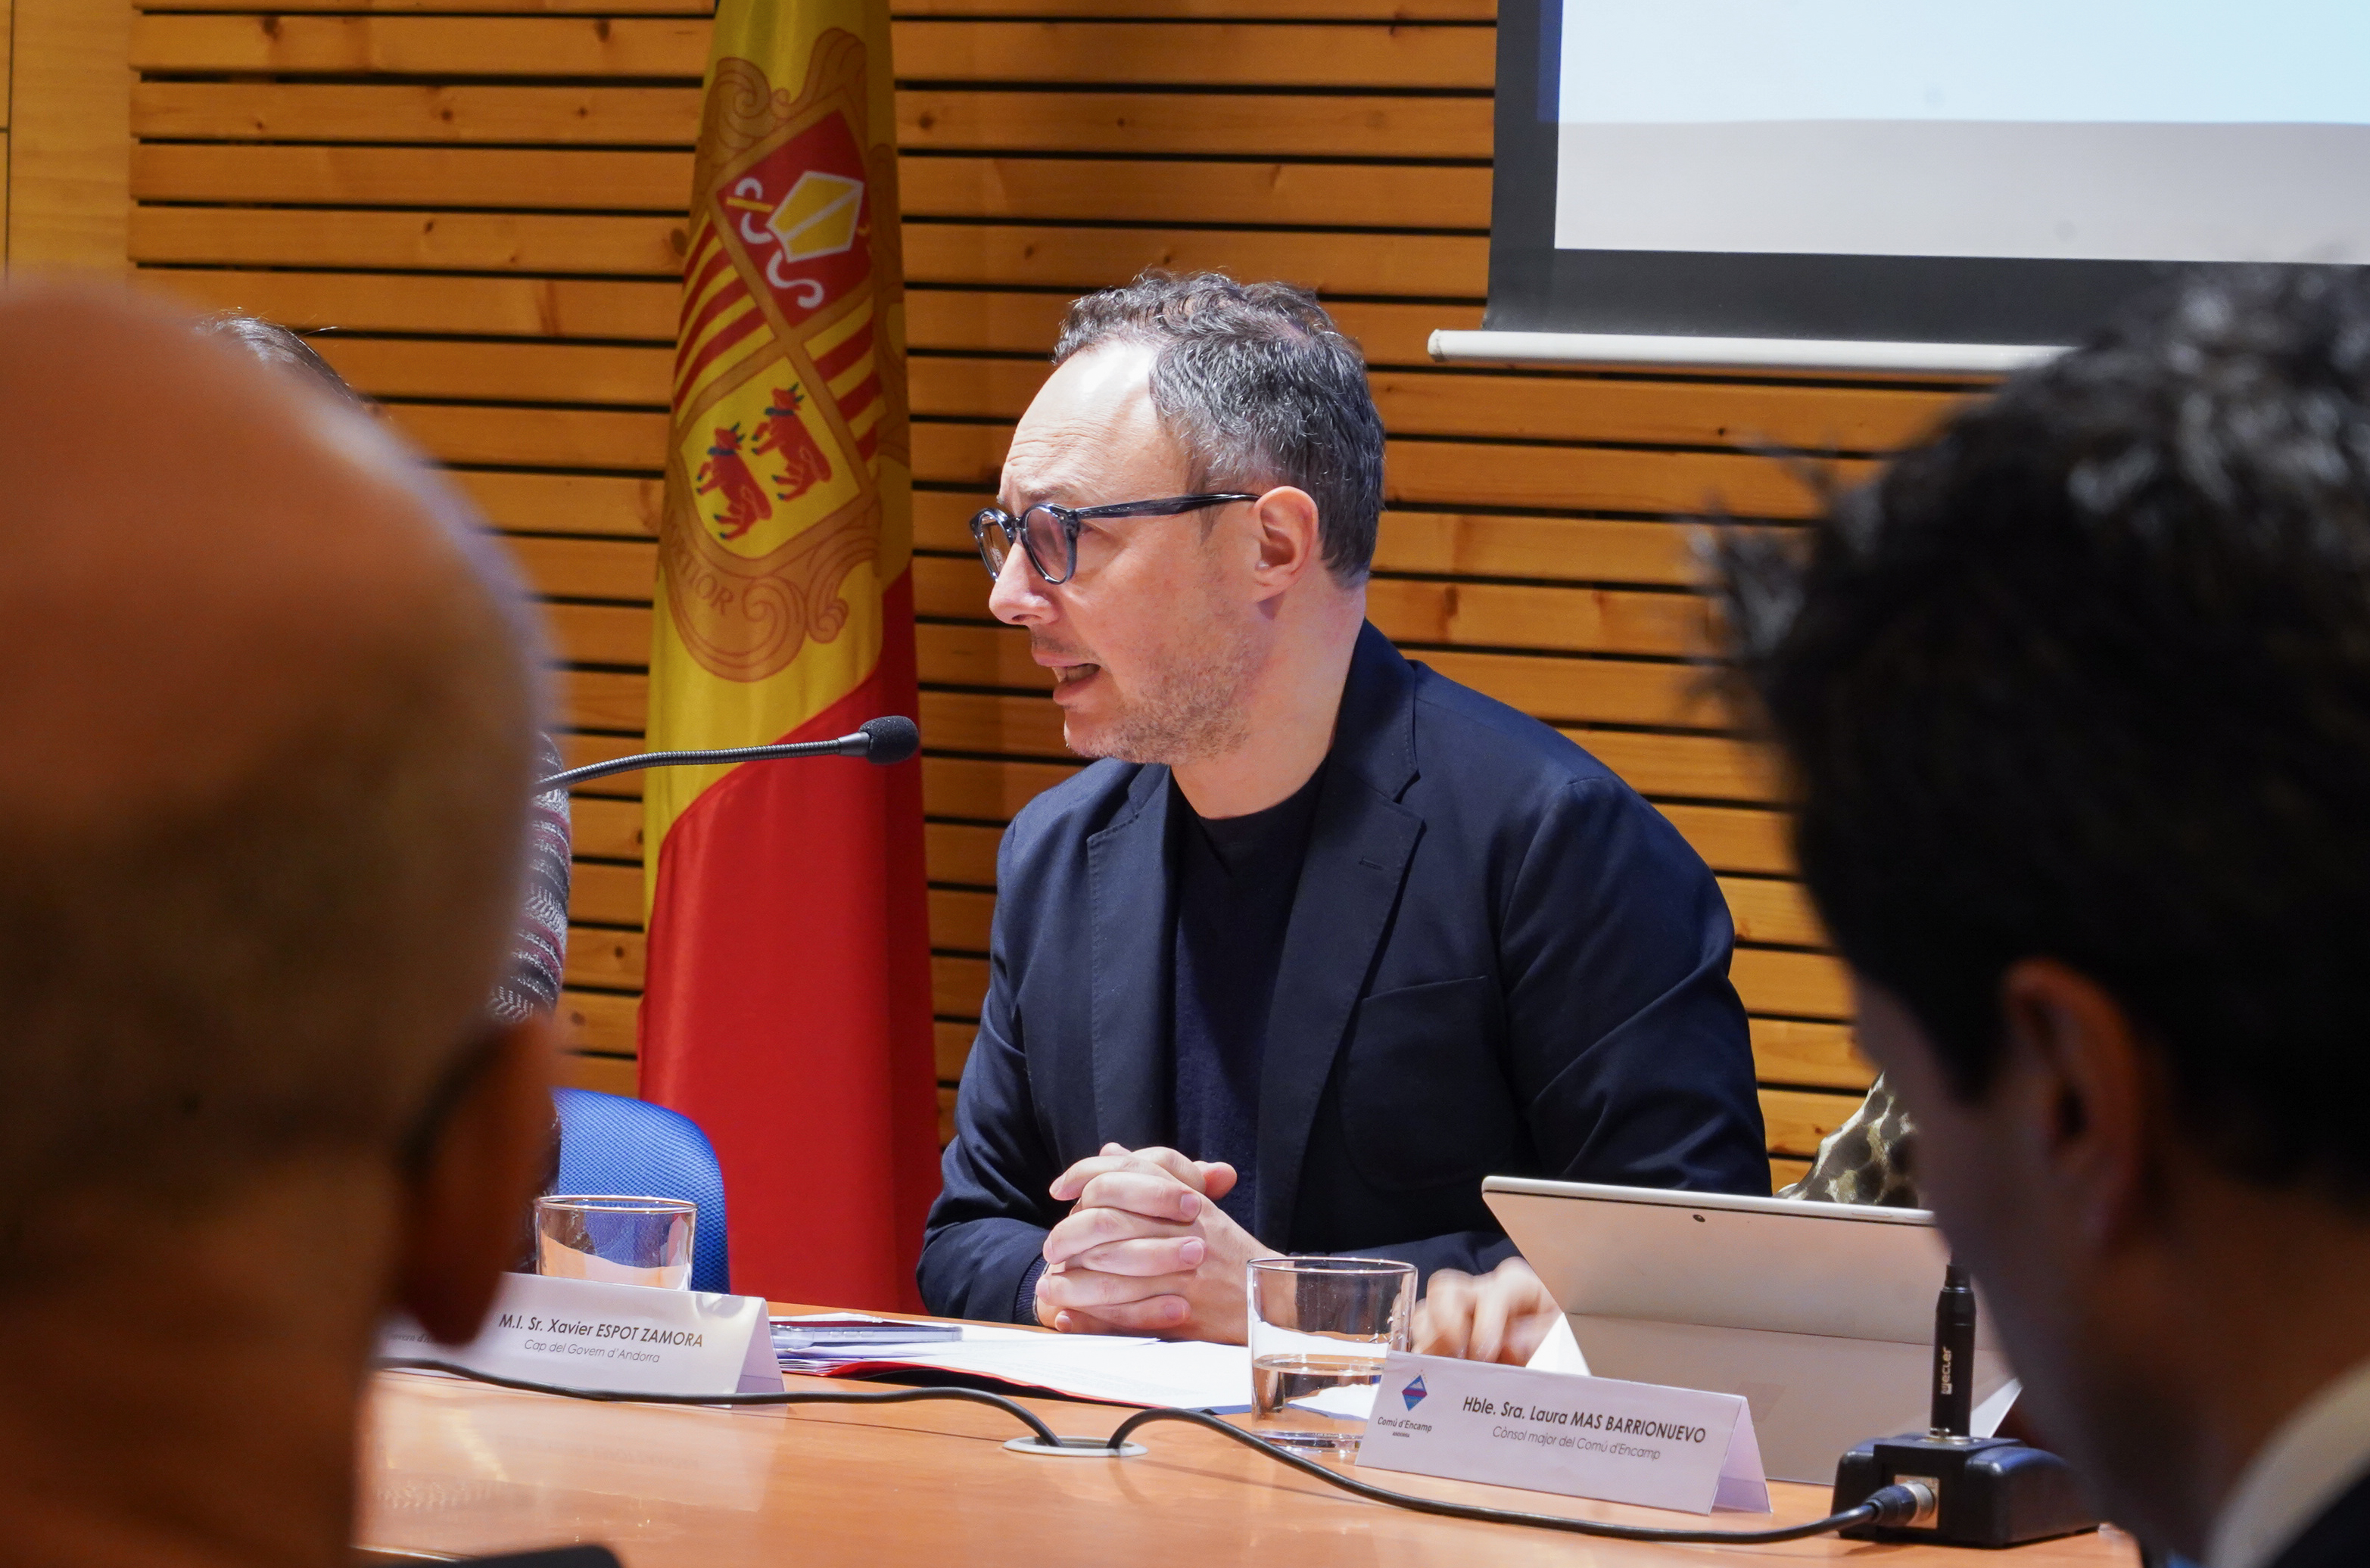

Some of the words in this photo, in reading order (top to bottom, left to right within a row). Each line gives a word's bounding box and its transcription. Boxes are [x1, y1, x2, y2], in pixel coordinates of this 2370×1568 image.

[498, 1314, 523, 1330] M.I.
[528, 1316, 543, 1331] Sr.
[547, 1318, 593, 1336] Xavier
[595, 1324, 640, 1340] ESPOT
[640, 1328, 702, 1347] ZAMORA
[525, 1339, 547, 1352] Cap
[549, 1342, 566, 1353] del
[568, 1343, 605, 1357] Govern
[607, 1349, 660, 1363] d'Andorra
[1377, 1416, 1398, 1428] Comú
[1462, 1396, 1496, 1415] Hble.
[1500, 1402, 1524, 1420] Sra.
[1530, 1405, 1568, 1425] Laura
[1570, 1411, 1603, 1430] MAS
[1605, 1416, 1706, 1443] BARRIONUEVO
[1493, 1426, 1528, 1441] Cònsol
[1528, 1433, 1557, 1446] major
[1559, 1436, 1575, 1448] del
[1577, 1438, 1608, 1452] Comú
[1609, 1442, 1661, 1461] d'Encamp
